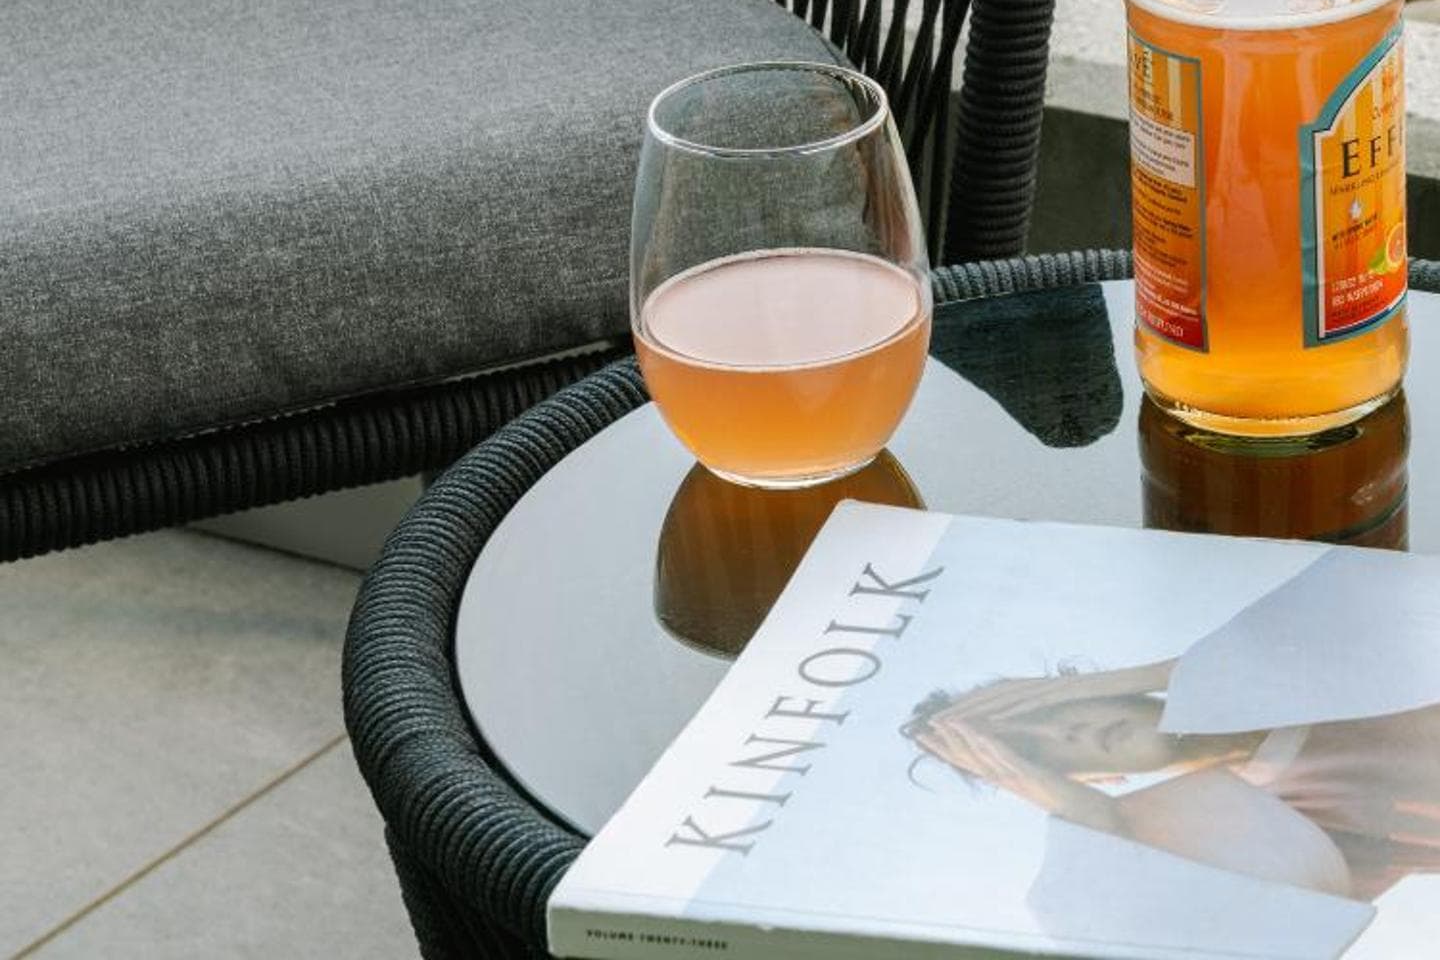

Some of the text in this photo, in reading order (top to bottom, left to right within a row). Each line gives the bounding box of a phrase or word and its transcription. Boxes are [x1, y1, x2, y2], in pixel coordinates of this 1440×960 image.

[1341, 123, 1403, 179] EFF
[664, 562, 945, 857] KINFOLK
[586, 928, 634, 941] VOLUME
